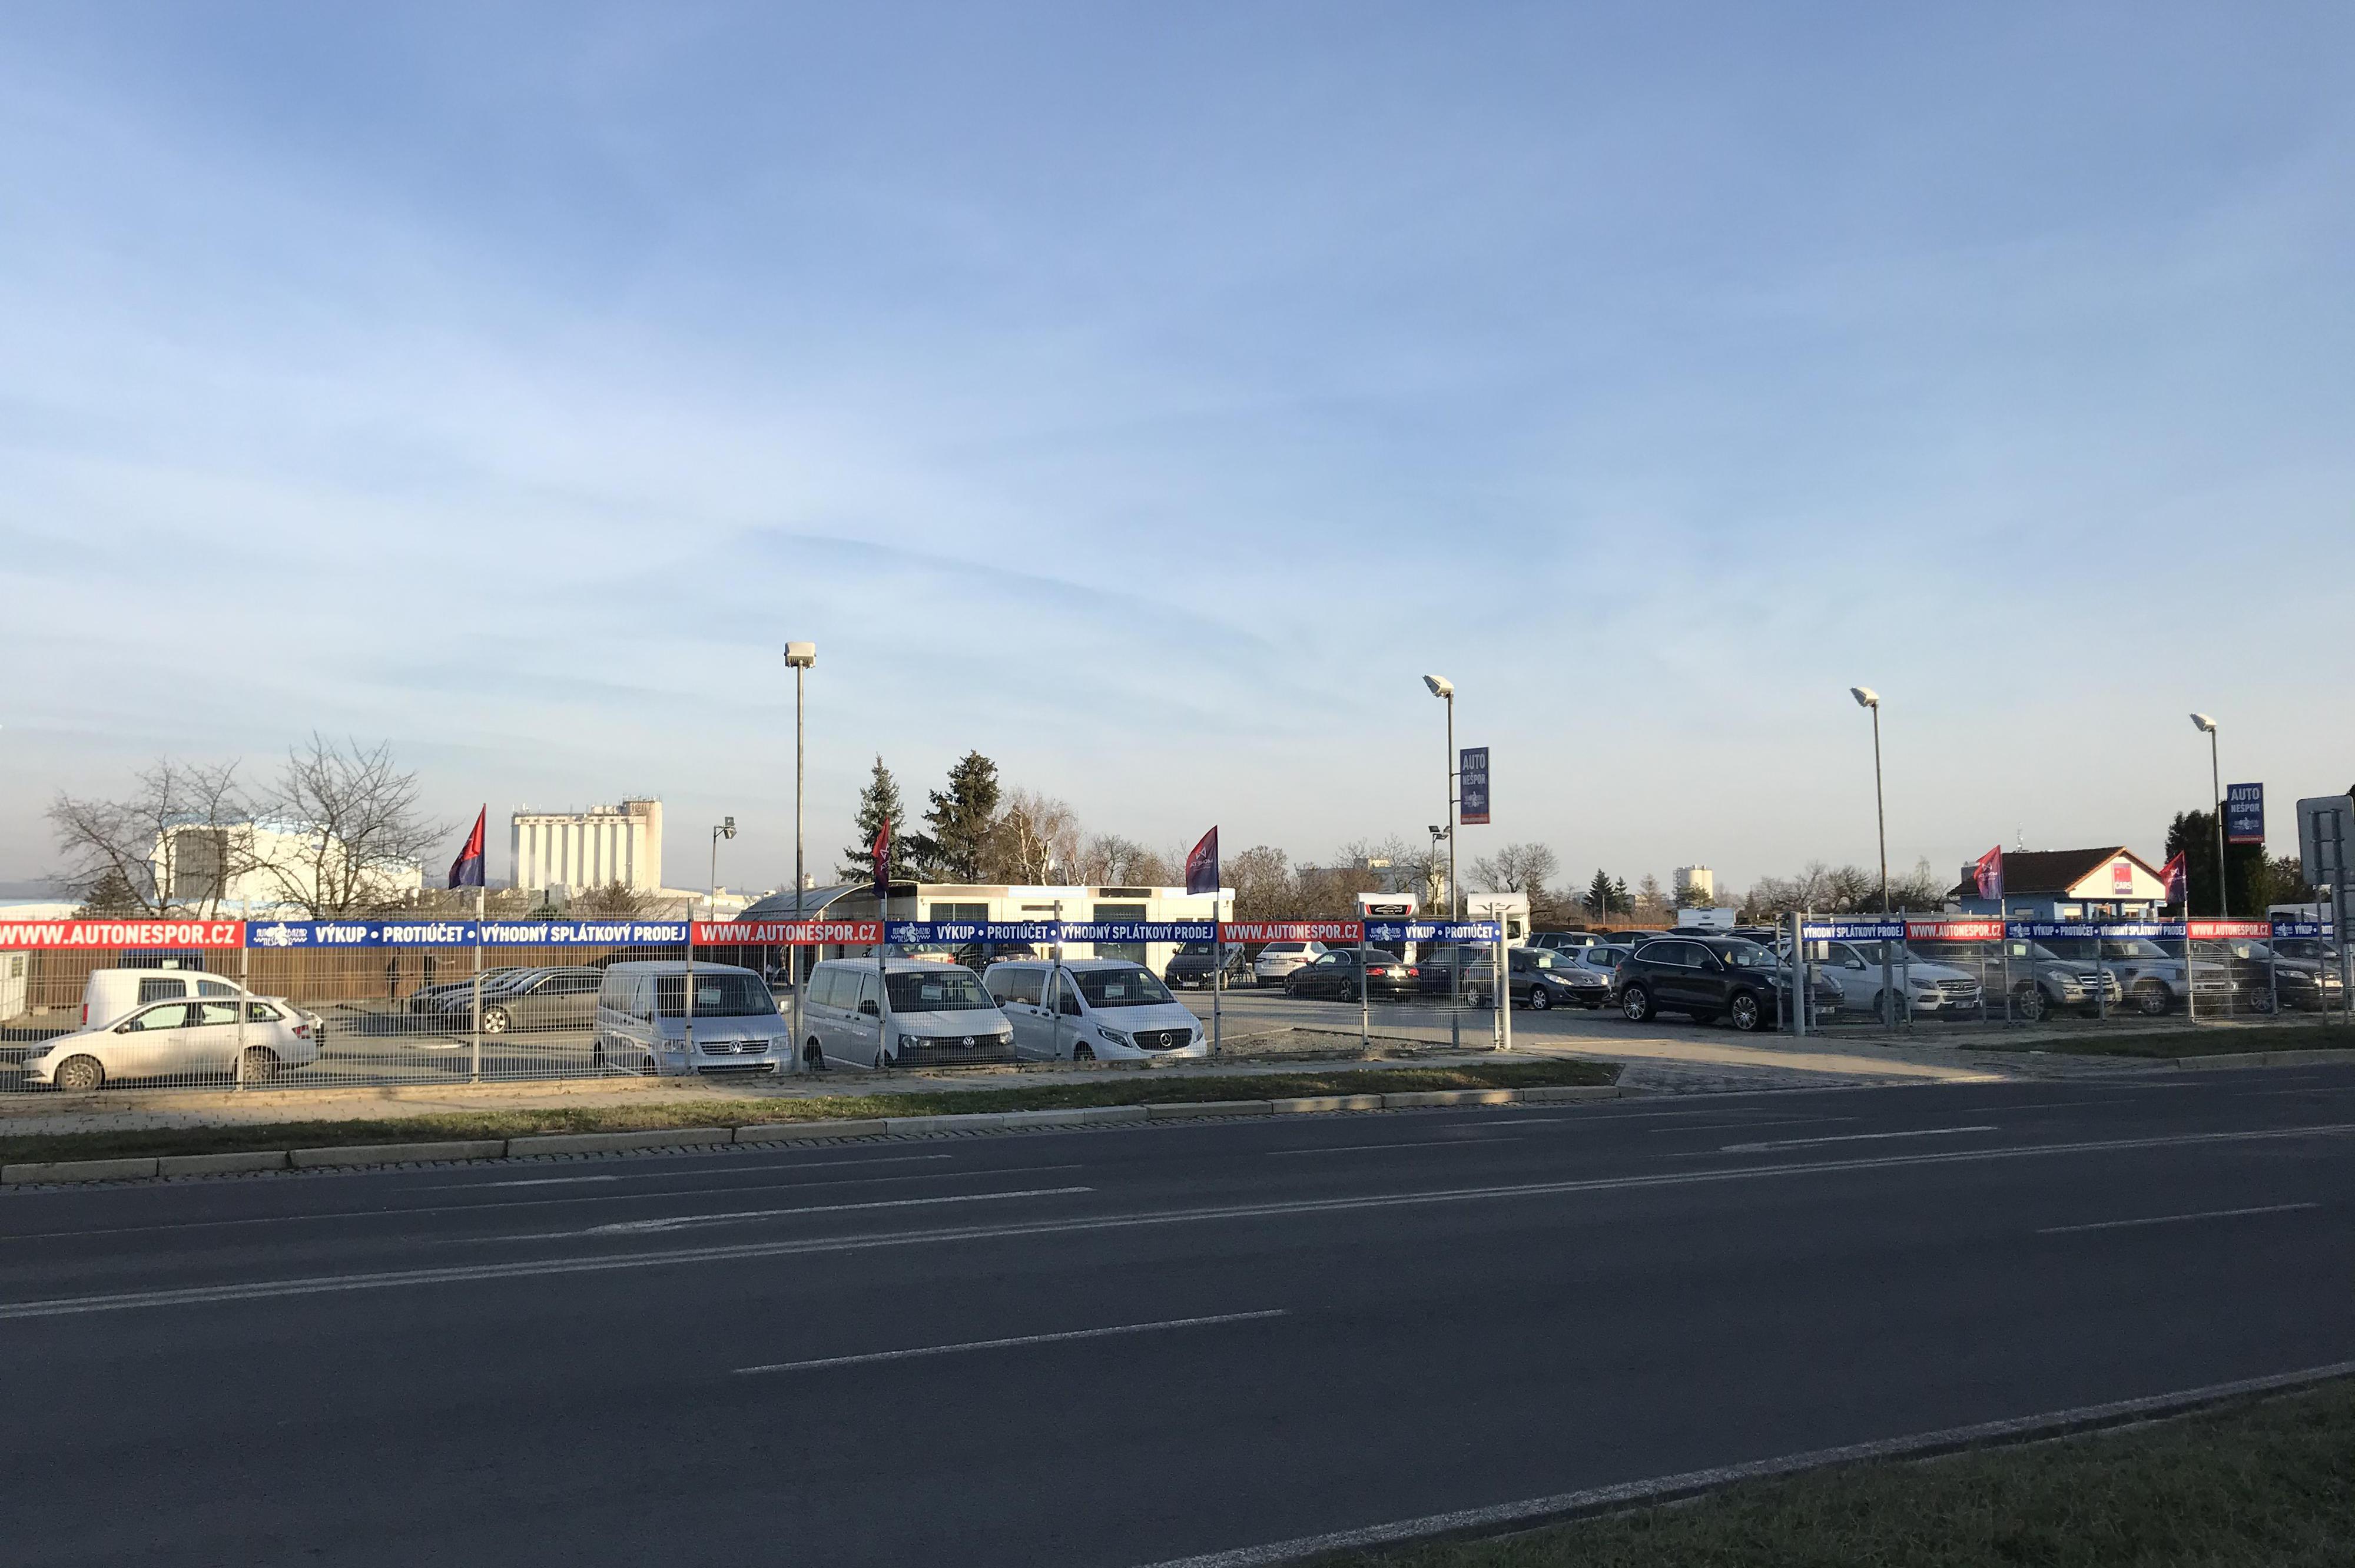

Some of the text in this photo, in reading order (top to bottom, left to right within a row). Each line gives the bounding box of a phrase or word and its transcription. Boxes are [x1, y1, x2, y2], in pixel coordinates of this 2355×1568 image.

[1462, 753, 1486, 770] AUTO
[1462, 772, 1486, 786] NEŠPOR
[2231, 787, 2260, 801] AUTO
[2231, 802, 2260, 813] NEŠPOR
[0, 924, 235, 945] WWW.AUTONESPOR.CZ
[316, 922, 686, 943] VÝKUP PROTIÚČET VÝHODNÝ SPLÁTKOVÝ PRODEJ
[701, 924, 876, 942] WWW.AUTONESPOR.CZ
[937, 922, 1213, 939] VÝKUP PROTIÚČET VÝHODNÝ SPLÁTKOVÝ PRODEJ
[1224, 924, 1358, 940] WWW.AUTONESPOR.CZ
[1405, 923, 1435, 939] VÝKUP
[1445, 922, 1493, 939] PROTIÚČET
[1803, 924, 1903, 938] VÝHODNÝ SPLÁTKOVÝ PRODEJ
[1910, 924, 2001, 937] WWW.AUTONESPOR.CZ
[2033, 923, 2054, 936] VÝKUP
[2060, 923, 2094, 936] PROTIÚČET
[2101, 923, 2128, 936] VÝHODNÝ
[2128, 923, 2162, 936] SPLÁTKOVÝ
[2163, 925, 2186, 936] PRODEJ
[2191, 924, 2268, 936] WWW.AUTONESPOR.CZ
